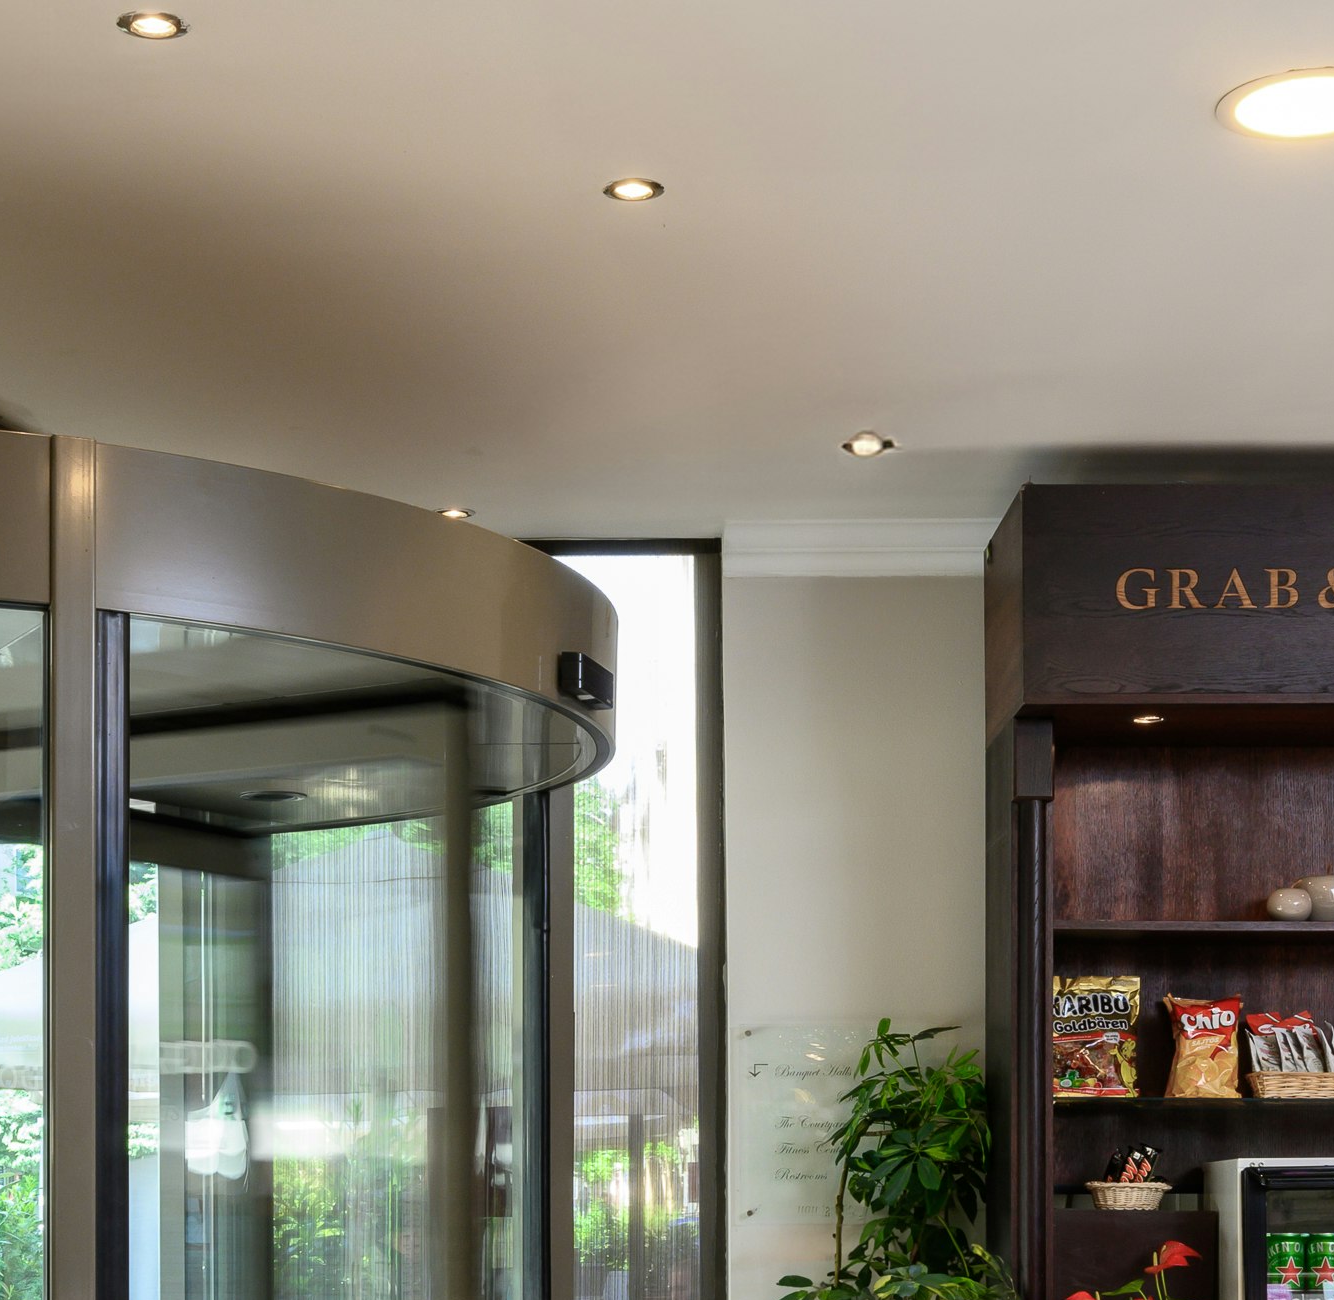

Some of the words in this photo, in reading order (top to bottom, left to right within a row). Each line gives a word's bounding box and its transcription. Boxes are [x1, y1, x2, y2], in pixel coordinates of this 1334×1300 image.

[1114, 566, 1299, 610] GRAB
[1053, 1017, 1129, 1033] Goldbären
[1180, 1007, 1236, 1032] Chio
[775, 1065, 820, 1081] Banquet
[823, 1064, 852, 1077] Halls
[775, 1116, 795, 1129] The
[798, 1115, 845, 1131] Courtyar
[775, 1142, 810, 1154] Fitness
[775, 1168, 828, 1181] Restrooms
